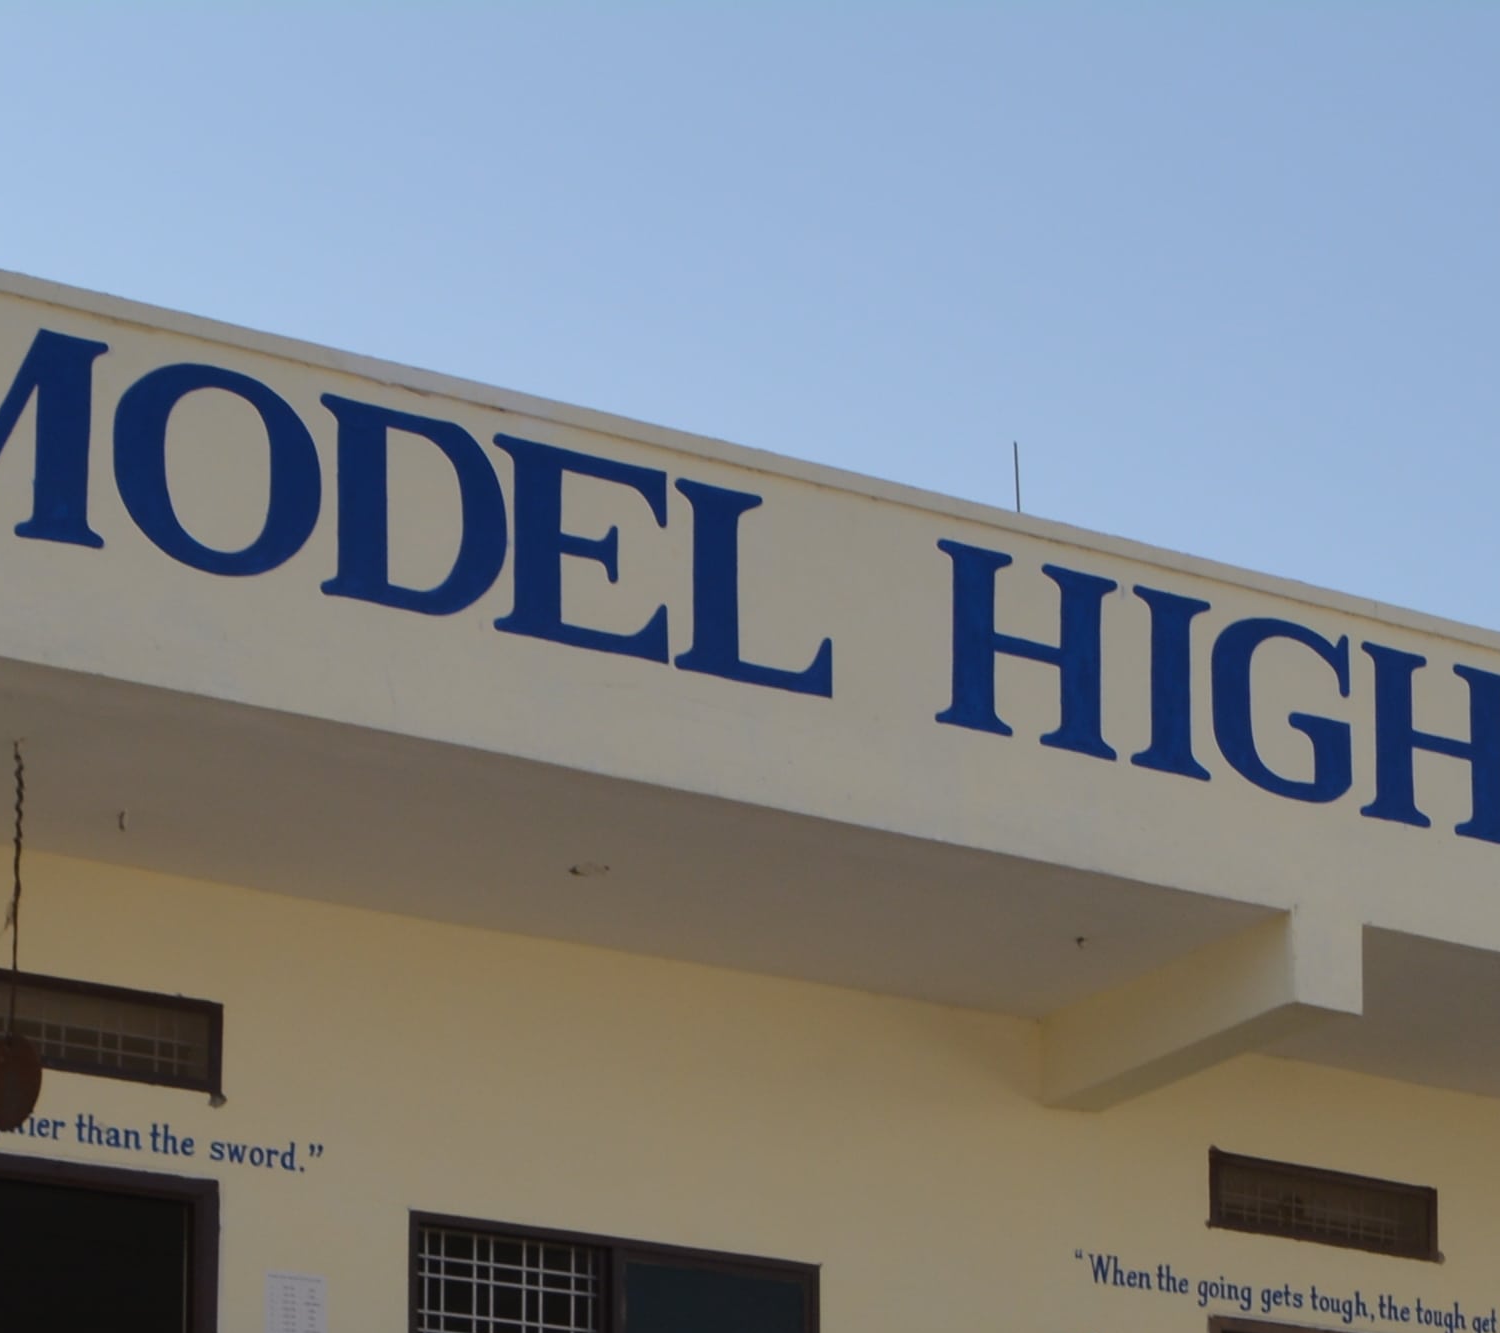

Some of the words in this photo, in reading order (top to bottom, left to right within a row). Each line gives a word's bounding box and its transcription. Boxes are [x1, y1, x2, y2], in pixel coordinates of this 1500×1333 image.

[75, 1113, 143, 1151] than
[149, 1123, 195, 1156] the
[1156, 1263, 1189, 1294] the
[1197, 1275, 1252, 1311] going
[1261, 1283, 1303, 1313] gets
[1310, 1285, 1375, 1324] tough,
[1378, 1293, 1411, 1322] the
